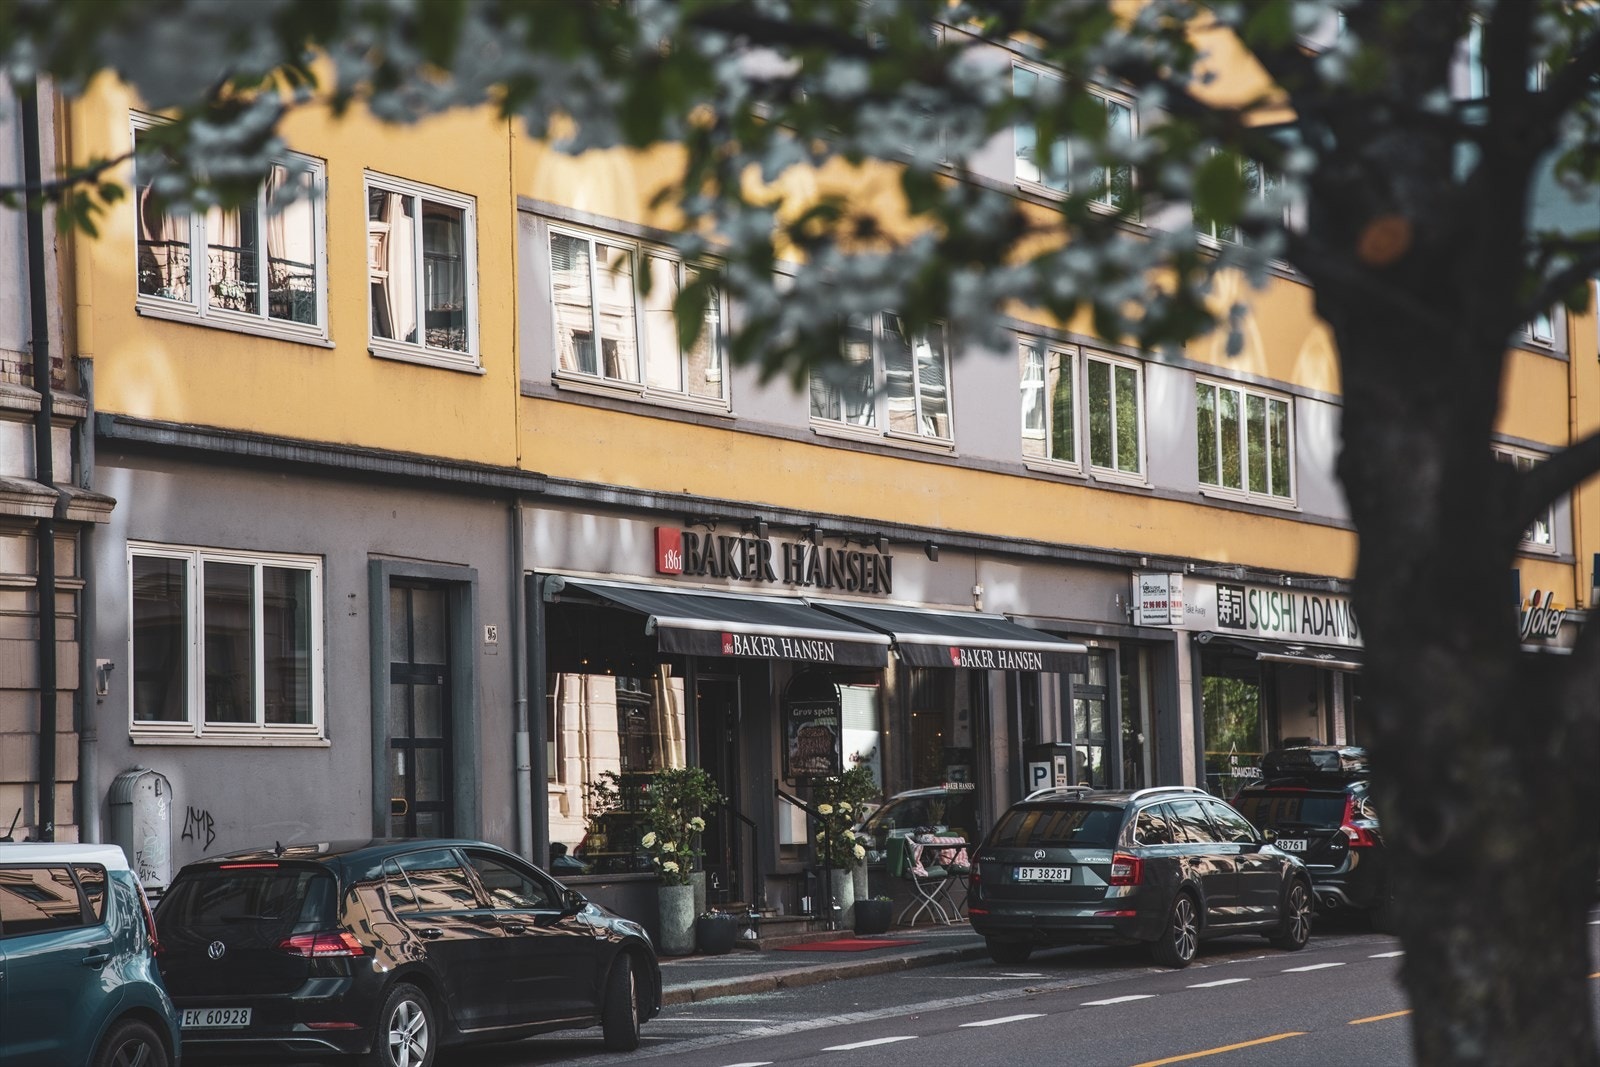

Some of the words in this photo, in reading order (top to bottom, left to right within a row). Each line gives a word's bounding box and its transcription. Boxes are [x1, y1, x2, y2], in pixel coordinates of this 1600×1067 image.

[664, 550, 682, 570] 1861
[682, 531, 778, 583] BAKER
[782, 542, 893, 594] HANSEN
[1218, 586, 1245, 625] 寿司
[1249, 588, 1297, 633] SUSHI
[1520, 589, 1567, 642] joker
[487, 627, 497, 640] 95
[733, 634, 779, 656] BAKER
[781, 638, 835, 662] HANSEN
[960, 648, 996, 669] BAKER
[998, 650, 1043, 670] HANSEN
[793, 708, 812, 716] Grov
[814, 707, 834, 717] spelt
[959, 782, 975, 790] HANSEN
[1034, 766, 1048, 787] P
[1277, 840, 1304, 850] 88761
[1022, 868, 1035, 878] BT
[1037, 868, 1068, 879] 38281
[185, 1010, 201, 1025] EK
[206, 1009, 248, 1025] 60928
